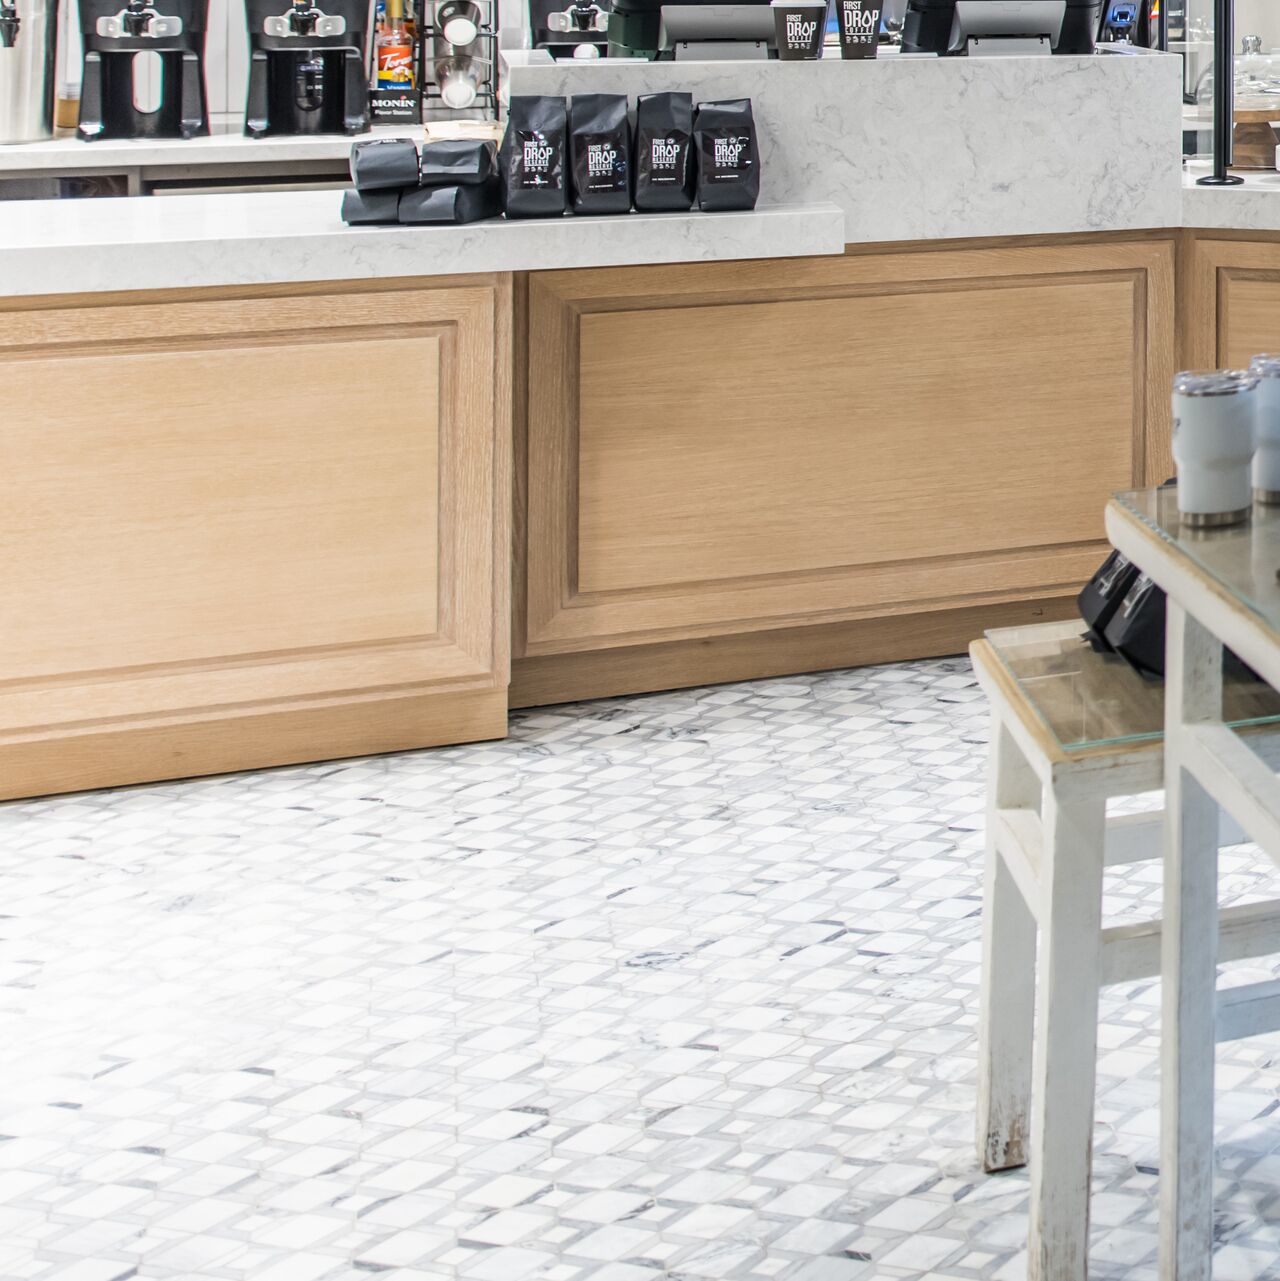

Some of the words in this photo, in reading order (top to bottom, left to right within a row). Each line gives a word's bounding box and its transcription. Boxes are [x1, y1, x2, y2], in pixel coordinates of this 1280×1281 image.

[843, 0, 862, 10] FIRST
[786, 14, 802, 22] FIRST
[844, 9, 880, 27] DROP
[787, 21, 817, 37] DROP
[845, 27, 874, 35] COFFEE
[371, 95, 417, 108] MONIN
[524, 147, 552, 160] DROP
[588, 150, 616, 164] DROP
[652, 144, 680, 157] DROP
[715, 144, 742, 157] DROP
